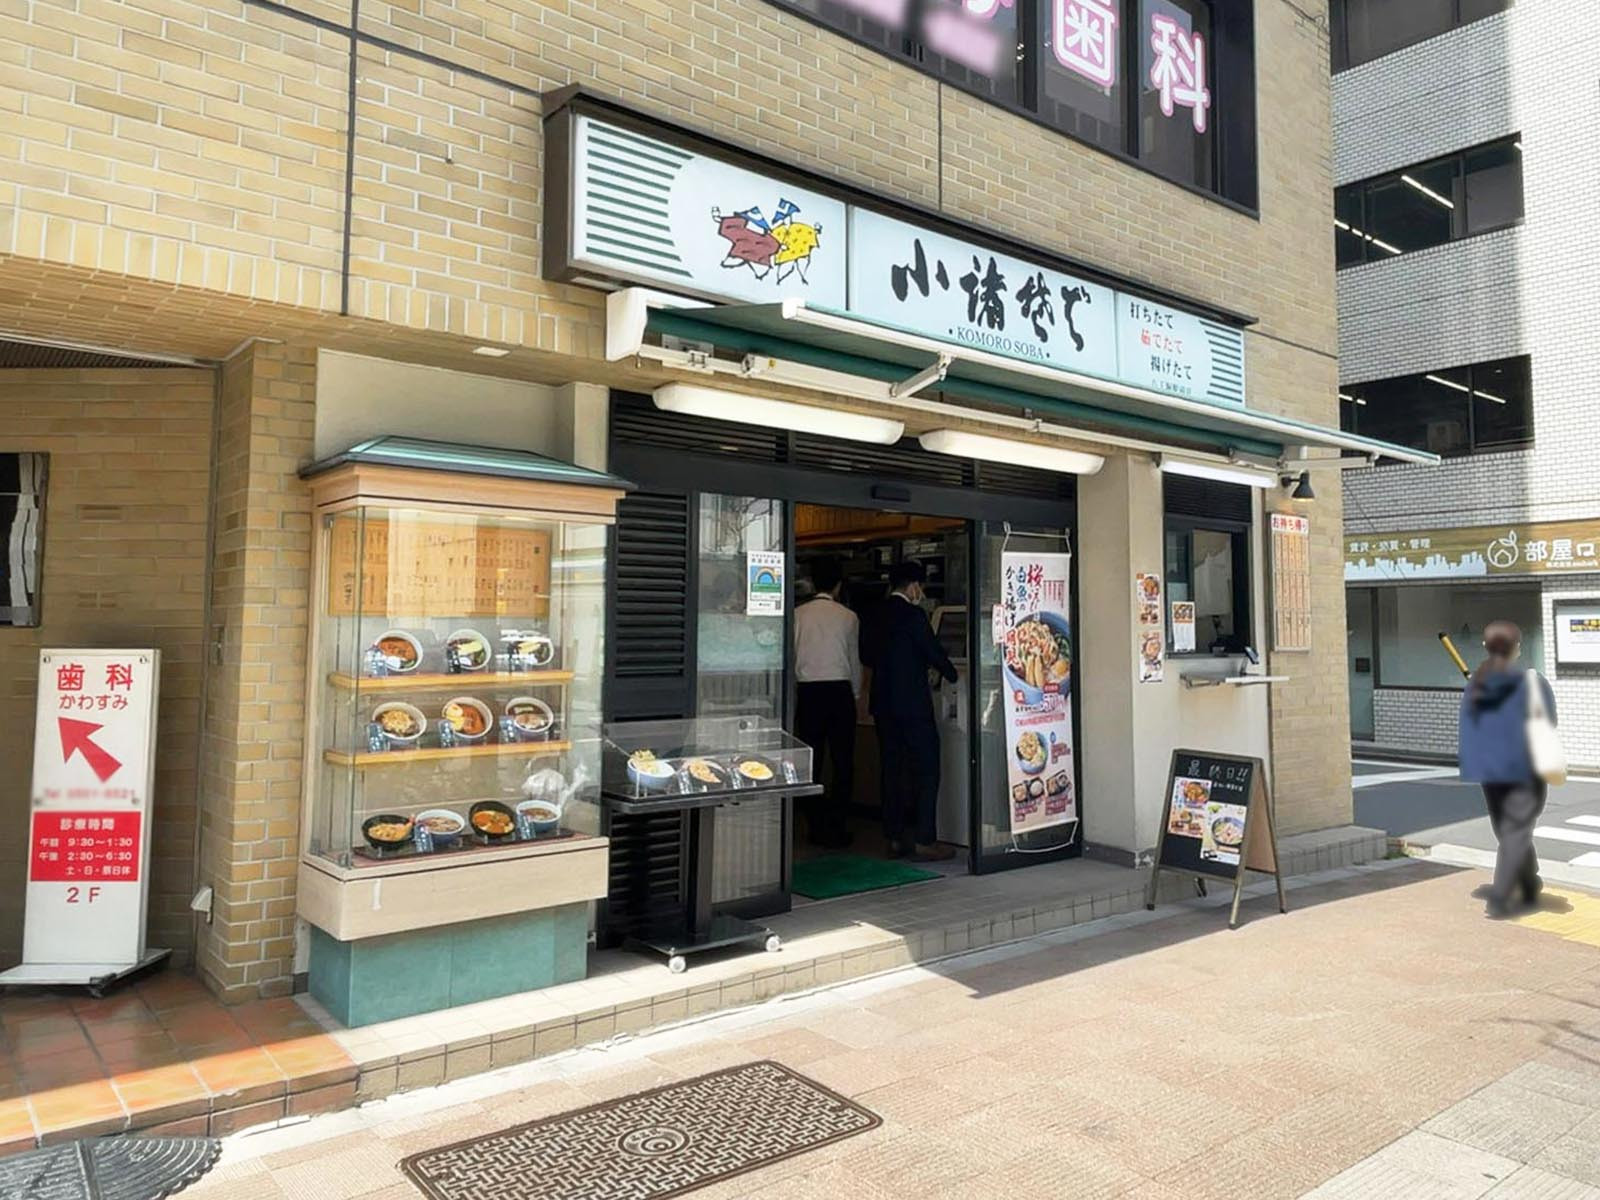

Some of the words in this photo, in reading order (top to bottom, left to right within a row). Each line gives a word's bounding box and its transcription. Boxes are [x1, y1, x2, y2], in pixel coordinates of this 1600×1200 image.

[1130, 301, 1174, 330] 打ちたて
[956, 325, 1012, 352] KOMORO
[1013, 340, 1045, 361] SOBA
[1150, 355, 1192, 381] 揚げたて
[57, 663, 133, 691] 歯科
[59, 694, 129, 711] かわすみ
